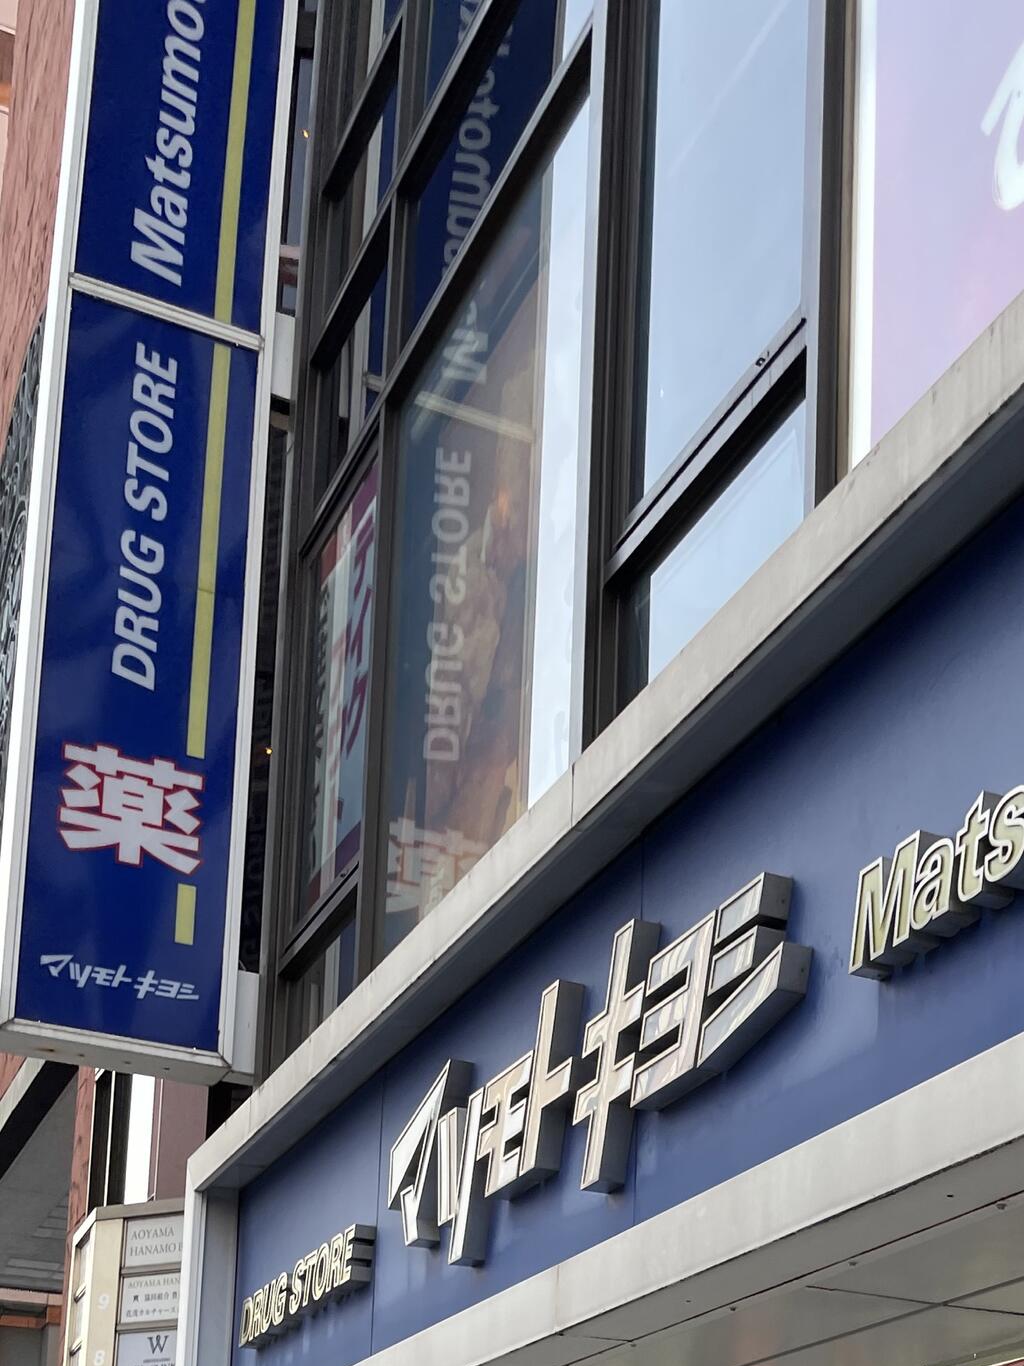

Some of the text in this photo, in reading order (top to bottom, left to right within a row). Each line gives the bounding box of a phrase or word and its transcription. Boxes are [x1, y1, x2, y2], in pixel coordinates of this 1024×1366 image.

[111, 342, 179, 691] DRUG STORE
[57, 741, 205, 875] 薬
[40, 954, 200, 1000] マツモトキヨシ
[387, 872, 808, 1266] マツモトキヨシ
[130, 1243, 176, 1257] HANAMO
[131, 1226, 174, 1240] AOYAMA
[97, 1294, 110, 1310] 9
[239, 1225, 366, 1348] DRUG STORE
[94, 1350, 105, 1366] 8
